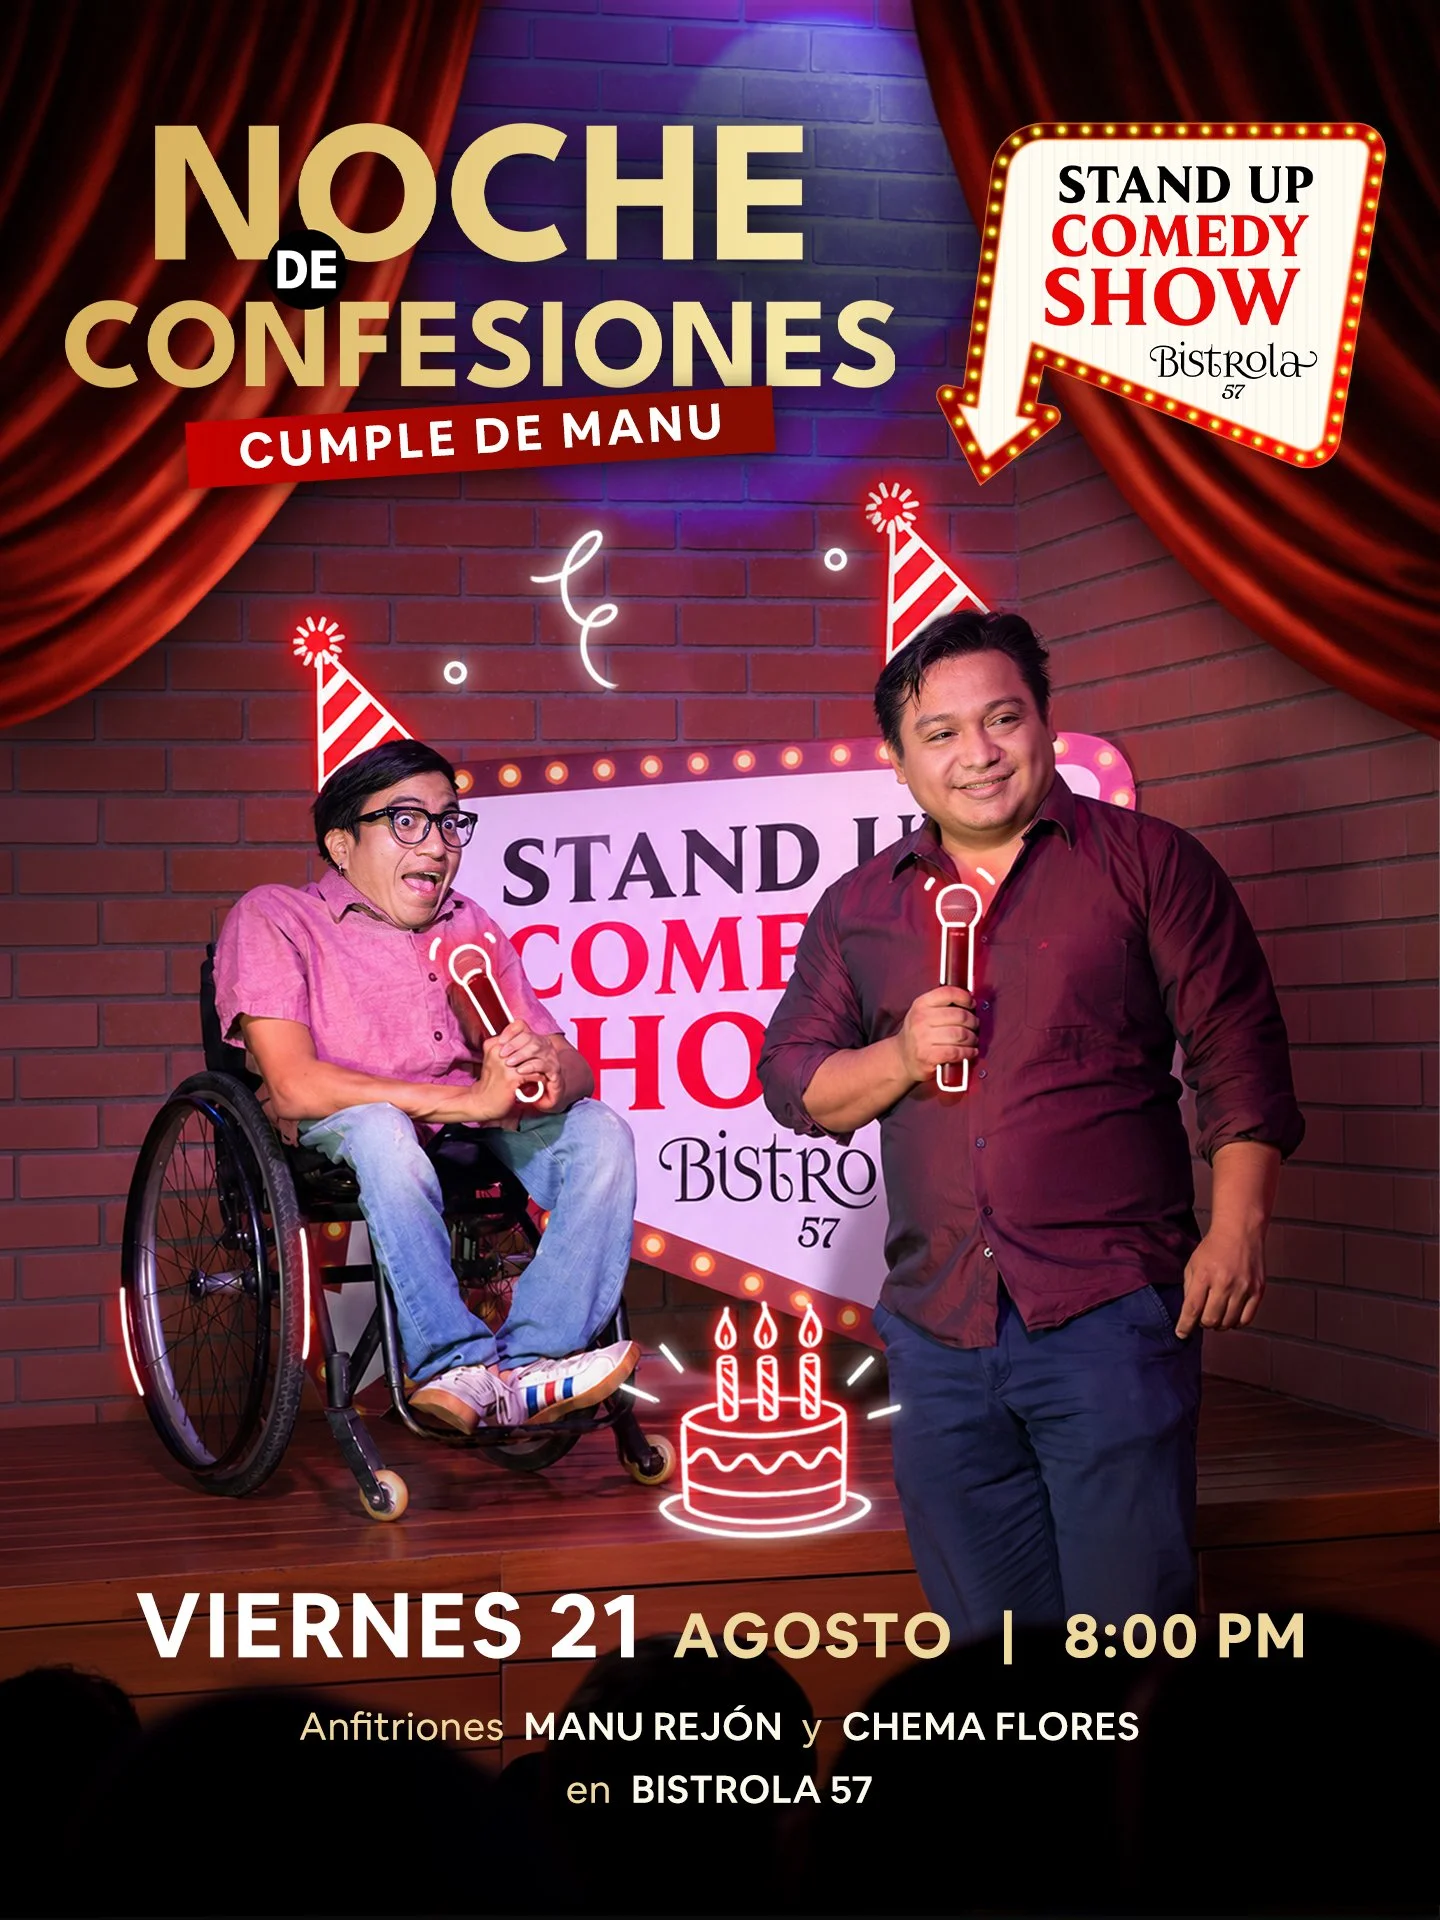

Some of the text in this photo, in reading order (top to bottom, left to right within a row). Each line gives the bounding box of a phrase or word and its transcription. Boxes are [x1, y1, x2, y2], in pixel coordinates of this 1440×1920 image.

[502, 821, 820, 907] STAND
[508, 913, 809, 999] COME
[570, 1011, 768, 1111] HO
[658, 1129, 878, 1210] Bistro
[797, 1215, 842, 1249] 57
